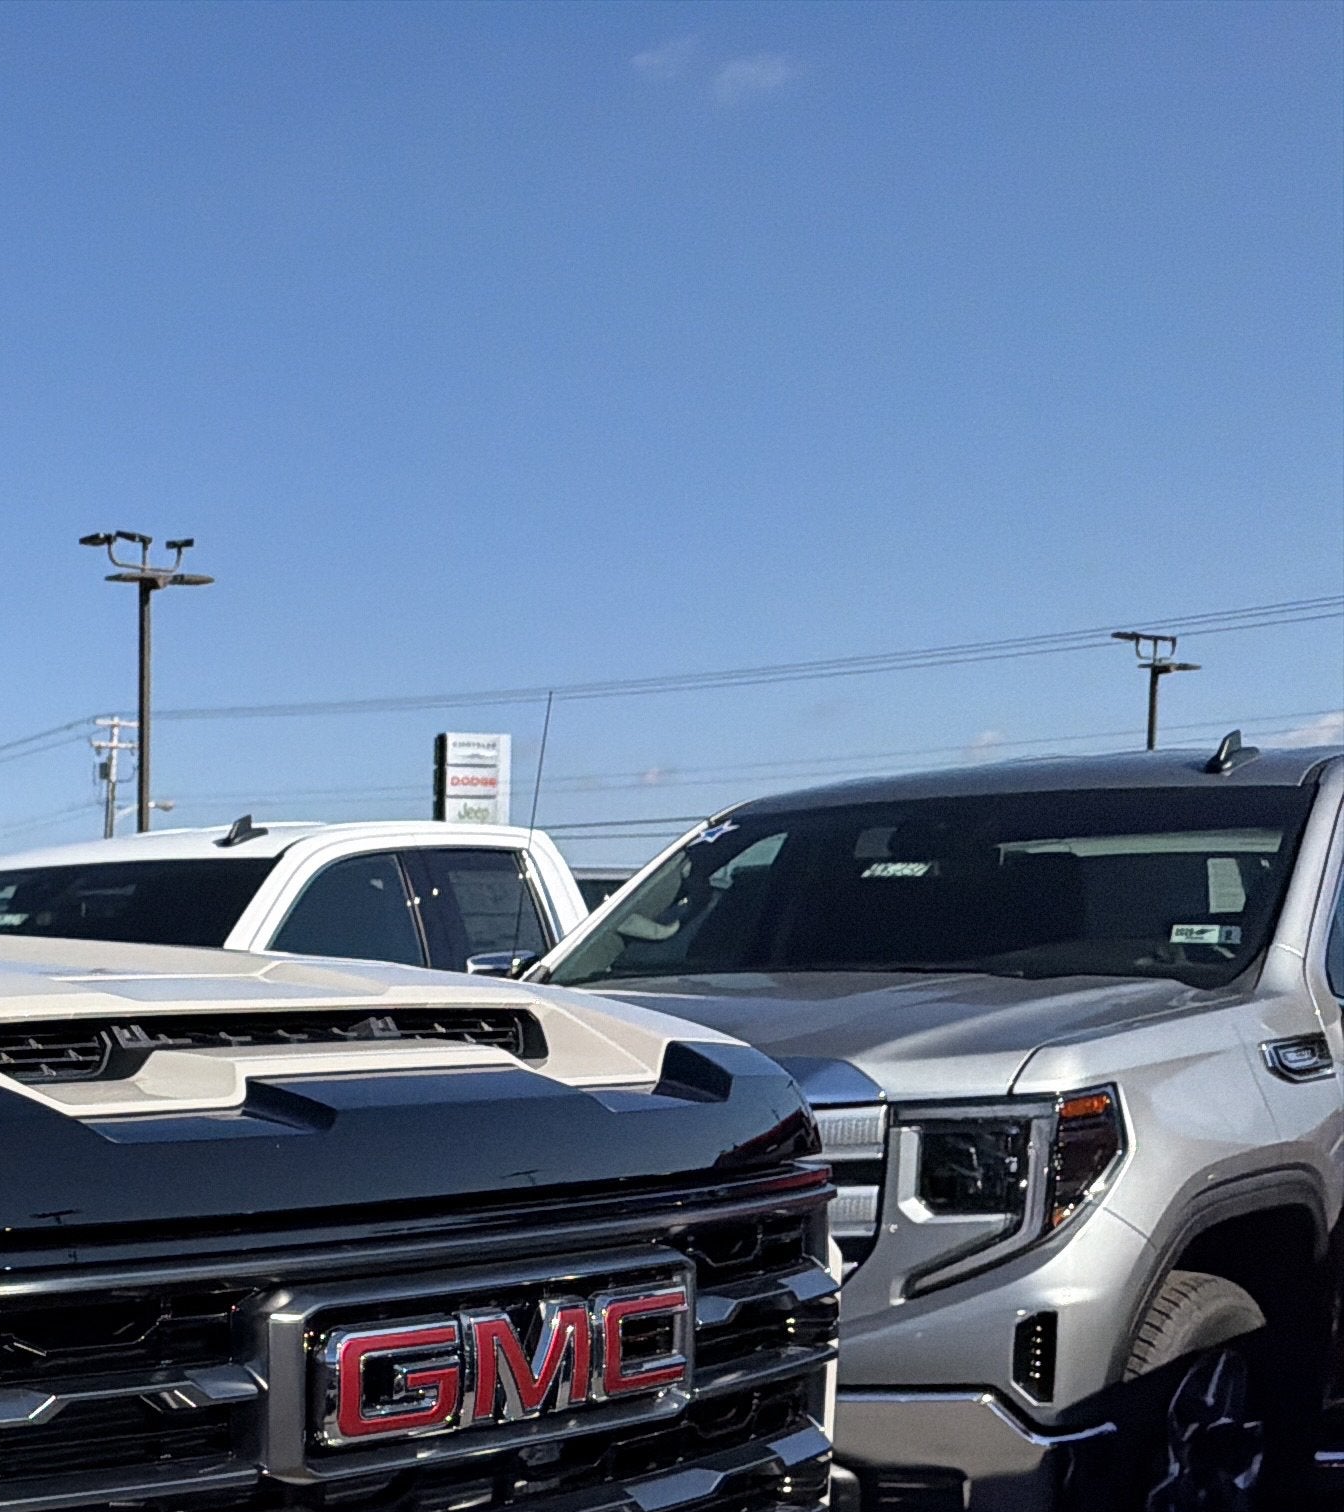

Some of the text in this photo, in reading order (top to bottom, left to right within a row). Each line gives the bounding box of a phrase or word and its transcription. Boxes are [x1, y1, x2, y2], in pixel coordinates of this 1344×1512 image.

[450, 776, 497, 788] DODGE
[457, 802, 490, 824] Jeep
[321, 1288, 690, 1447] GMC
